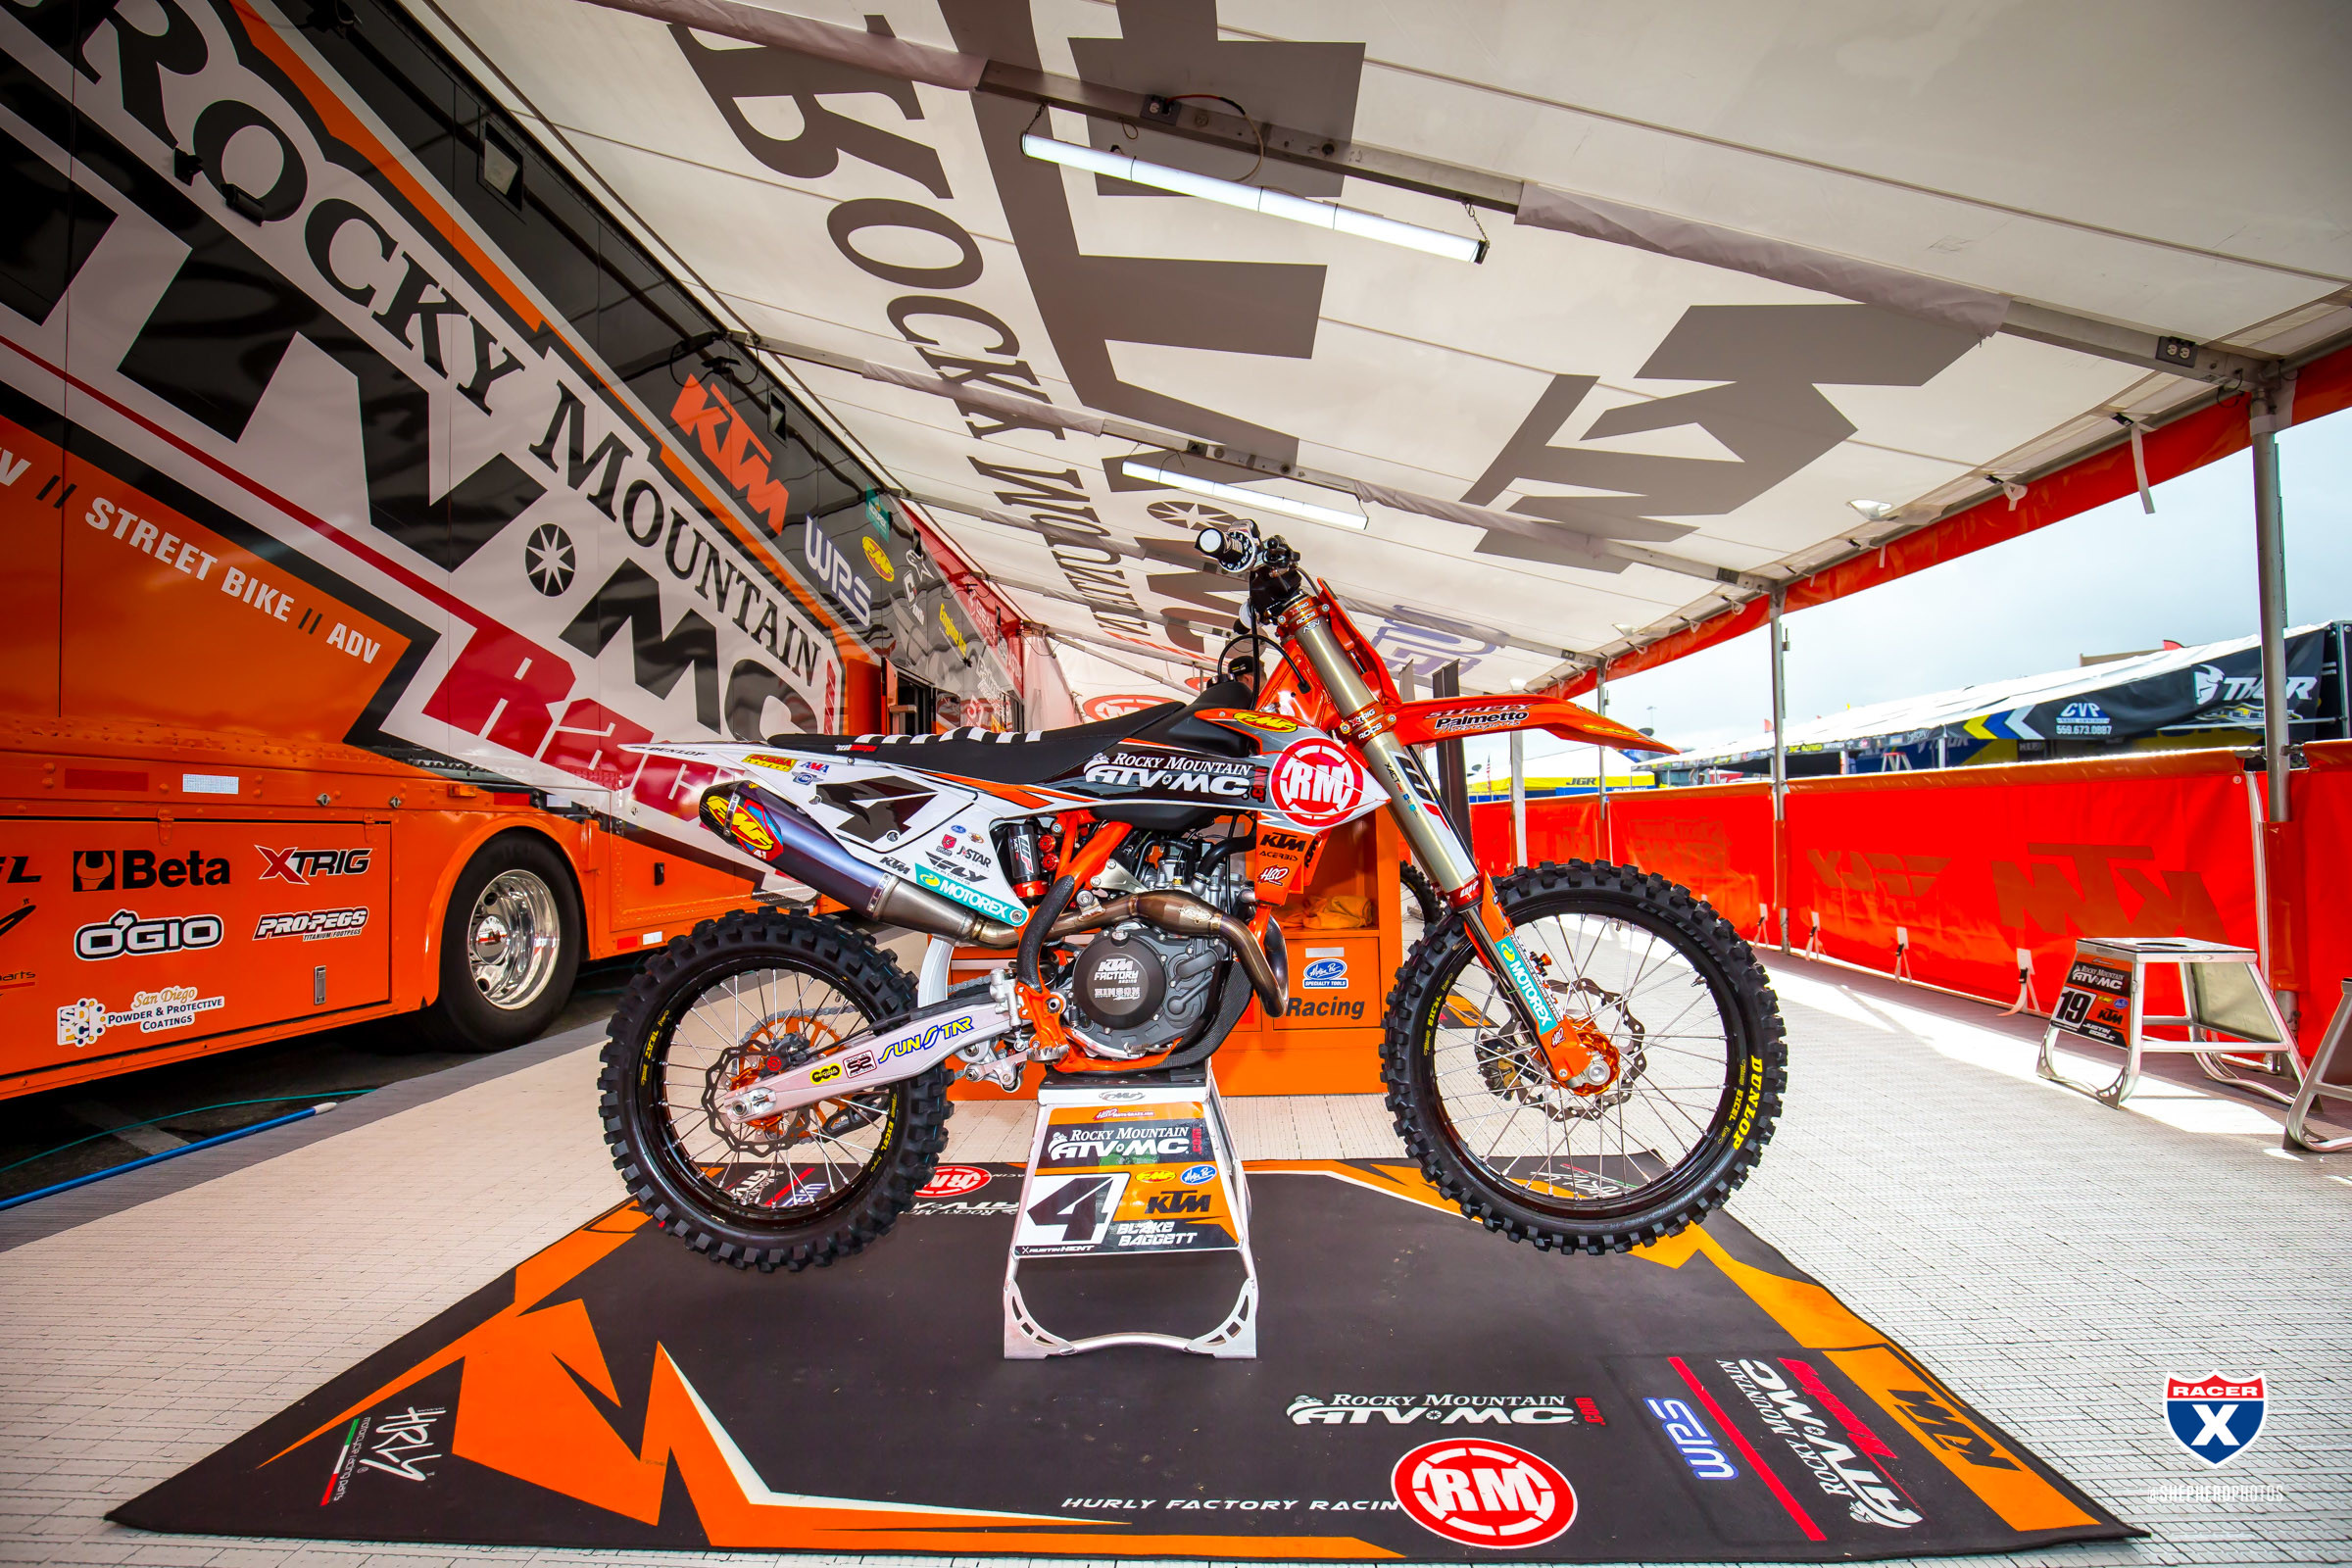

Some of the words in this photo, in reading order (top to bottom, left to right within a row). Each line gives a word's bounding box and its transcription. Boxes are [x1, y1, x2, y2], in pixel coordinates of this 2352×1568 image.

[669, 372, 789, 537] KTM
[528, 378, 822, 687] MOUNTAIN
[85, 497, 219, 581] STREET
[220, 566, 294, 622] BIKE
[326, 622, 381, 664] ADV
[805, 515, 872, 627] WPS
[2223, 677, 2318, 701] THR
[1348, 709, 1377, 727] XTRIG
[1435, 711, 1530, 729] Palmetto
[2060, 702, 2101, 717] CVP
[1235, 712, 1298, 732] FMF
[1358, 723, 1383, 740] ROCS
[800, 761, 830, 773] AMA
[1111, 753, 1166, 768] ROCKY
[1163, 756, 1253, 775] MOUNTAIN
[1287, 757, 1349, 804] RM
[1566, 777, 1596, 786] JGR
[1260, 832, 1307, 853] KTM
[122, 849, 231, 889] Beta
[254, 844, 372, 885] XTRIG
[879, 857, 911, 875] KTM
[940, 879, 1010, 919] MOTOREX
[1094, 970, 1139, 980] FACTORY
[1098, 958, 1133, 971] KTM
[2082, 965, 2098, 976] ROCKY
[133, 994, 158, 1008] San
[161, 988, 195, 1004] Diego
[1509, 959, 1552, 1027] MOTOREX
[108, 1009, 153, 1025] POWDER
[155, 1006, 165, 1016] &
[167, 998, 222, 1014] PROTECTIVE
[1286, 997, 1365, 1020] Racing
[1427, 995, 1442, 1027] EXCEL
[2056, 990, 2092, 1024] 19
[2097, 1007, 2124, 1025] KTM
[142, 1015, 193, 1030] COATINGS
[1728, 1089, 1743, 1121] EXCEL
[1733, 1054, 1763, 1151] DUNLOP
[881, 1120, 895, 1152] EXCEL
[1069, 1129, 1115, 1142] ROCKY
[1117, 1127, 1190, 1139] MOUNTAIN
[1026, 1177, 1113, 1242] 4
[1145, 1190, 1212, 1214] KTM
[1117, 1221, 1176, 1235] BLAKE
[1118, 1232, 1198, 1247] BAGGETT
[1330, 1394, 1418, 1406] ROCKY
[1421, 1394, 1567, 1406] MOUNTAIN
[1715, 1358, 1799, 1435] MOUNTAIN
[1648, 1399, 1735, 1479] WPS
[1887, 1389, 2023, 1472] KTM
[1785, 1438, 1855, 1496] ROCKY
[1061, 1498, 1157, 1510] HURLY
[1165, 1499, 1300, 1511] FACTORY
[1308, 1499, 1400, 1511] RACIN
